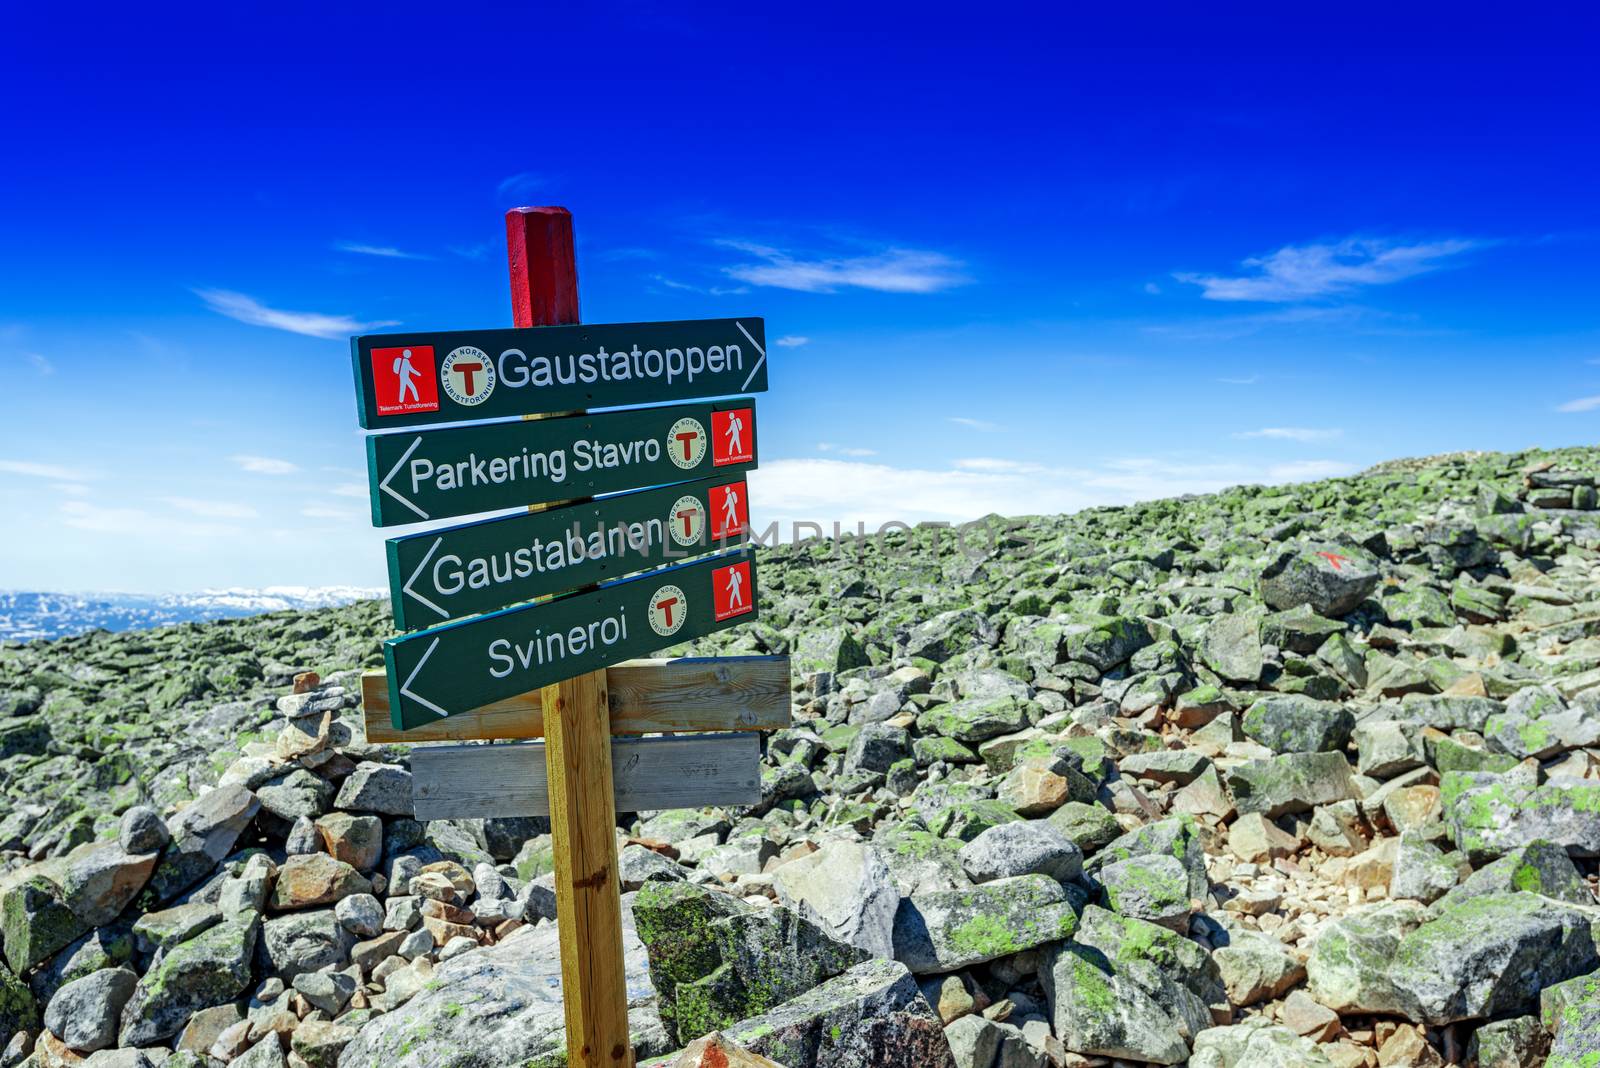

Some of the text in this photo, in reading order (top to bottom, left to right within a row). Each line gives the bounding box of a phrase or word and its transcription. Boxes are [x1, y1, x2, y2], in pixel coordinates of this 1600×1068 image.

[445, 348, 490, 369] DEN NORSKE
[498, 343, 743, 389] Gaustatoppen
[443, 376, 495, 404] TURISTFORENING
[453, 363, 483, 397] T
[675, 431, 698, 461] T
[410, 437, 661, 494] Parkering Stavro
[432, 517, 664, 596] Gaustabanen
[656, 597, 678, 627] T
[488, 604, 629, 678] Svineroi
